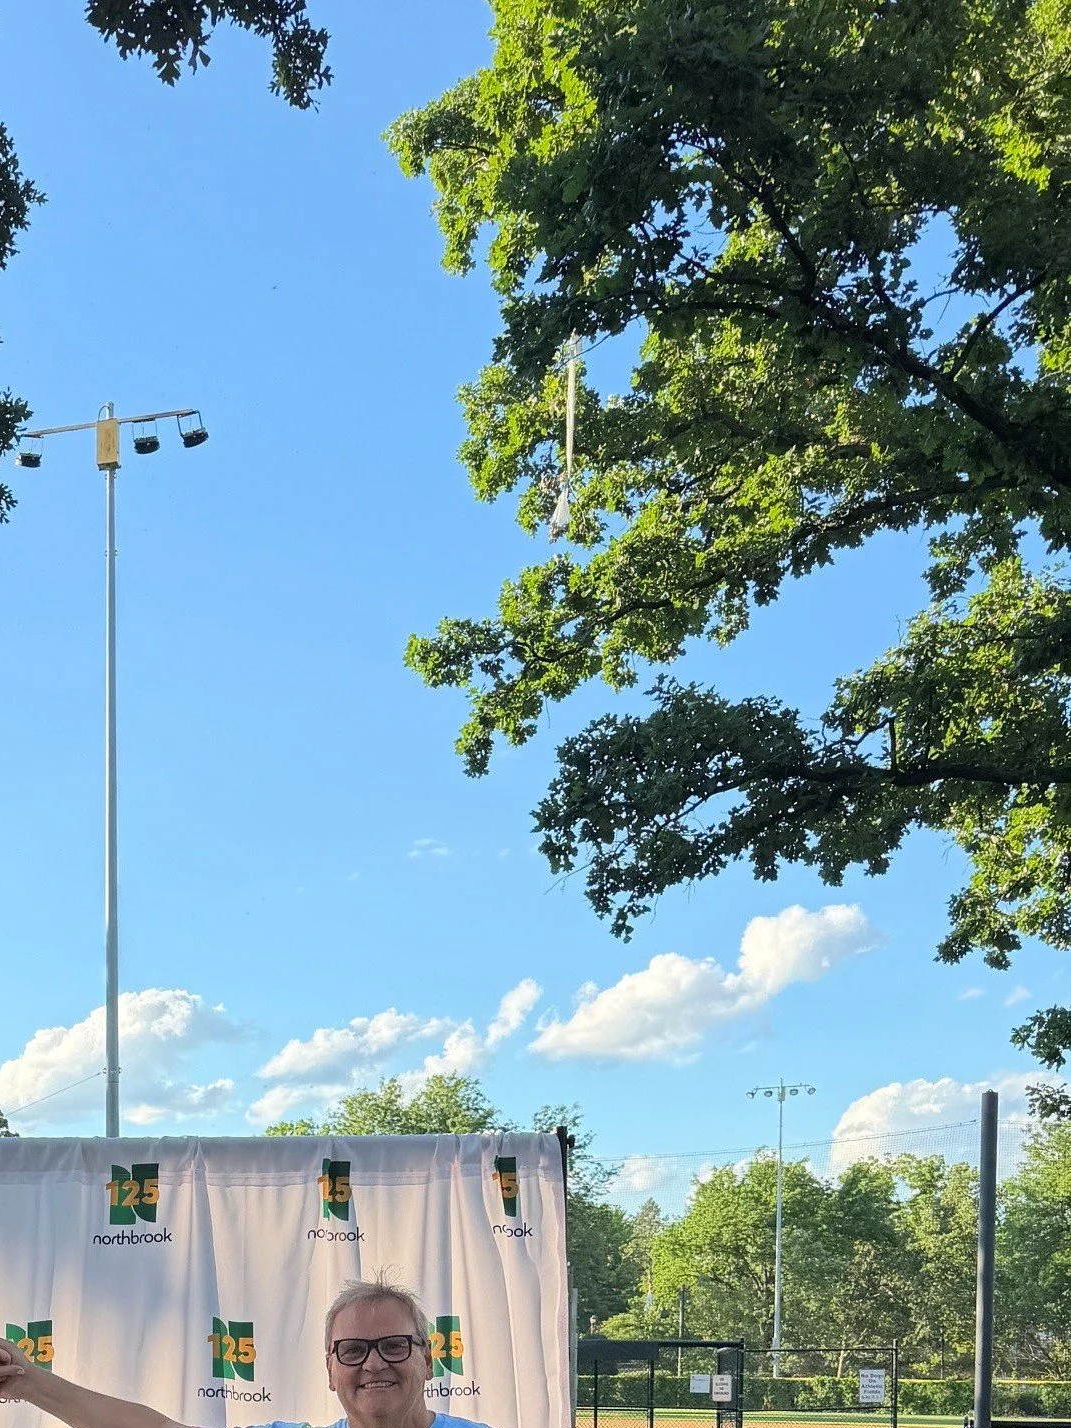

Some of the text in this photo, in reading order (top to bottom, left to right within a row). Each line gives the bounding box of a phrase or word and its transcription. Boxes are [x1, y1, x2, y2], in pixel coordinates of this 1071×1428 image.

[105, 1178, 159, 1206] 125
[92, 1228, 172, 1245] northbrook
[17, 1335, 55, 1363] 25
[208, 1334, 256, 1363] 125
[429, 1330, 464, 1358] 25
[197, 1385, 271, 1402] northbrook
